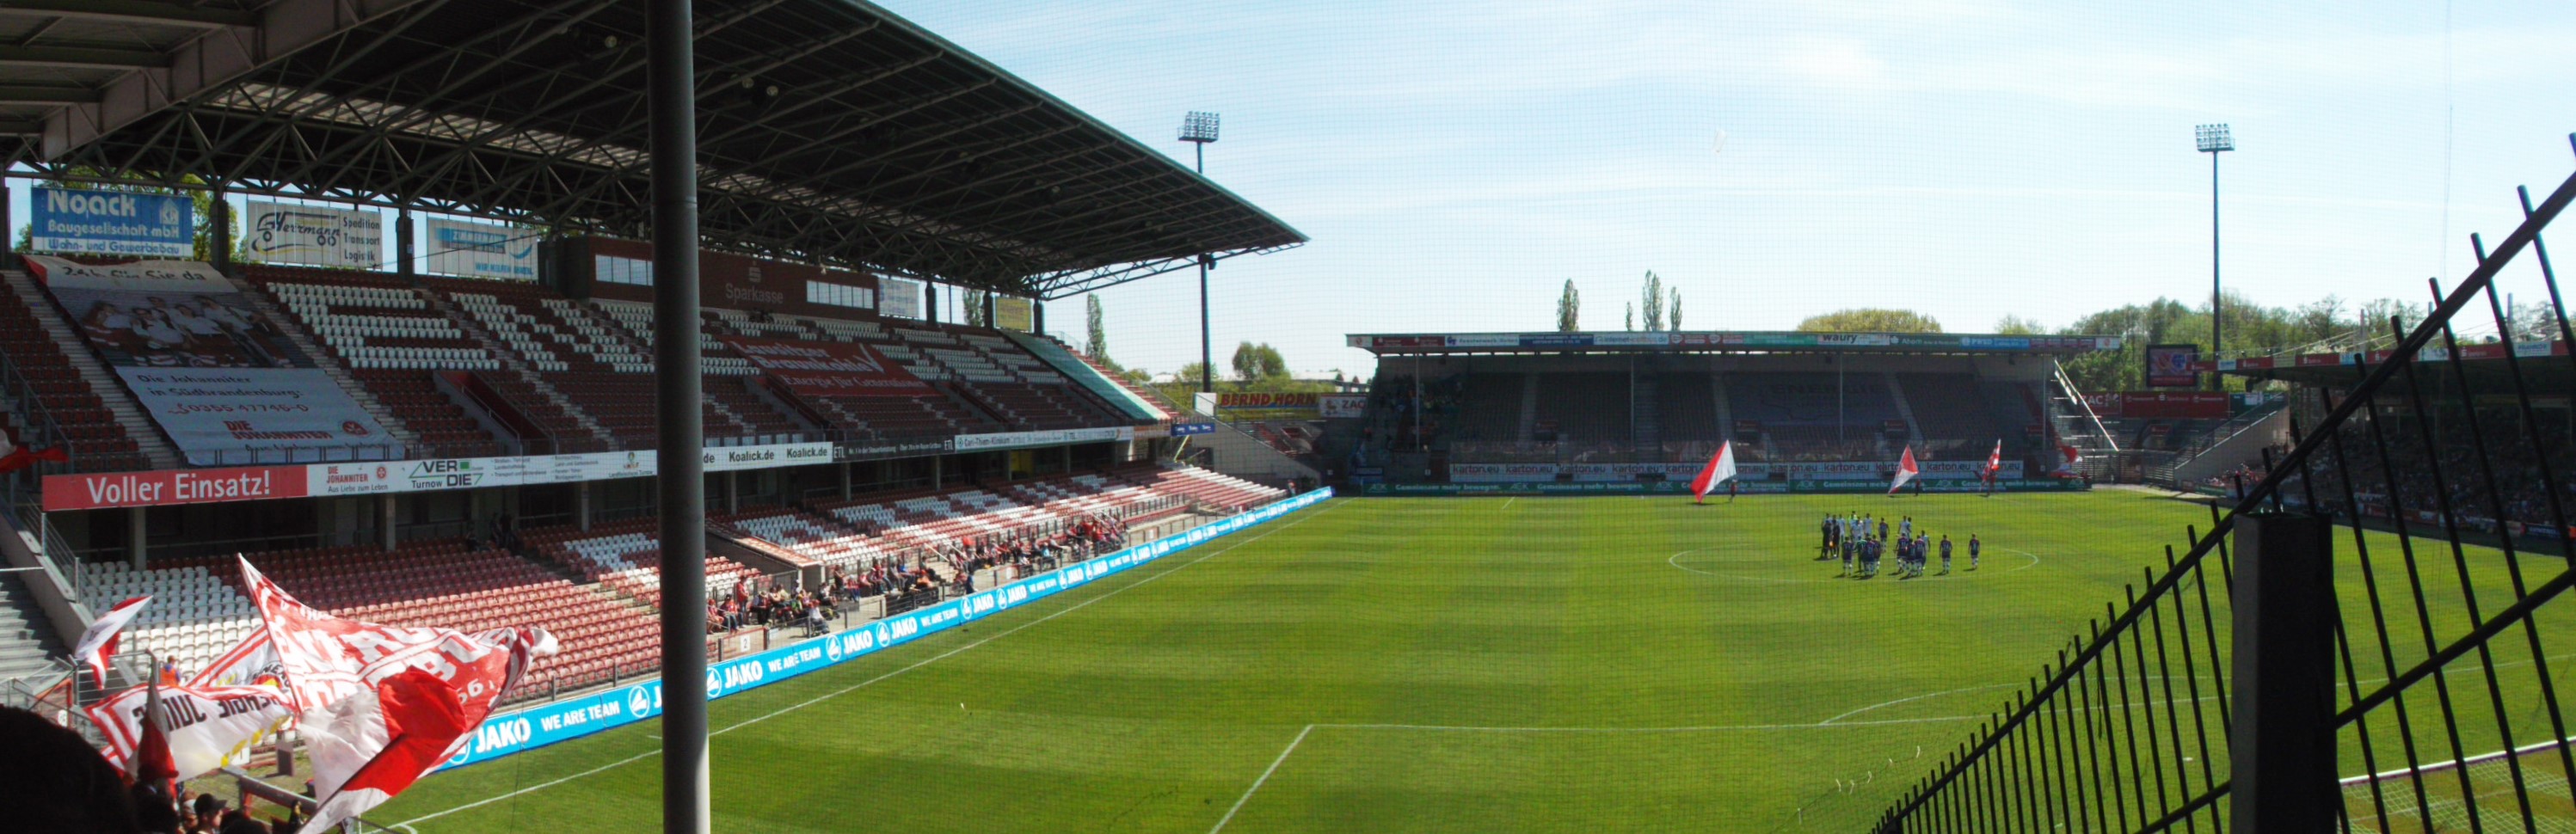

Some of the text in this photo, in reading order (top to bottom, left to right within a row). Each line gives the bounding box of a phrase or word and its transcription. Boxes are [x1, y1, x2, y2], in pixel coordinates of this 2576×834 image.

[47, 189, 136, 217] Noack
[48, 219, 179, 238] Baugesellschaft mbH
[265, 212, 340, 236] Herrmann
[343, 217, 380, 230] Spedition
[344, 233, 380, 246] Transport
[48, 239, 180, 254] Wohn- und Gewerbebau
[344, 250, 375, 261] Logistik
[182, 270, 206, 280] da
[725, 283, 784, 304] Sparkasse
[750, 354, 875, 372] Braunkohle
[137, 373, 252, 384] Die Johanniter
[150, 387, 304, 398] in Südbrandenburg:
[1220, 393, 1318, 407] BERND HORN
[224, 420, 254, 431] DIE
[231, 431, 334, 440] JOHANNITER
[729, 450, 774, 463] Koalick.de
[786, 447, 827, 458] Koalick.de
[328, 466, 339, 475] DIE
[422, 459, 458, 473] VER
[1453, 464, 1500, 474] karton.eu
[1506, 464, 1553, 474] karton.eu
[1559, 464, 1607, 474] karton.eu
[1612, 464, 1659, 473] karton.eu
[1824, 463, 1869, 471] karton.eu
[1927, 463, 1970, 471] karton.eu
[327, 474, 368, 483] JOHANNITER
[411, 479, 442, 488] Turnow
[446, 473, 472, 487] DIE
[86, 469, 271, 505] Voller Einsatz!
[1007, 585, 1028, 603] JAKO
[973, 594, 994, 613] JAKO
[892, 608, 958, 640] JAKO WE ARE TEAM
[742, 638, 748, 650] 2
[844, 630, 873, 654] JAKO
[725, 647, 821, 688] JAKO WE ARE TEAM
[475, 701, 620, 752] JAKO WE ARE TEAM
